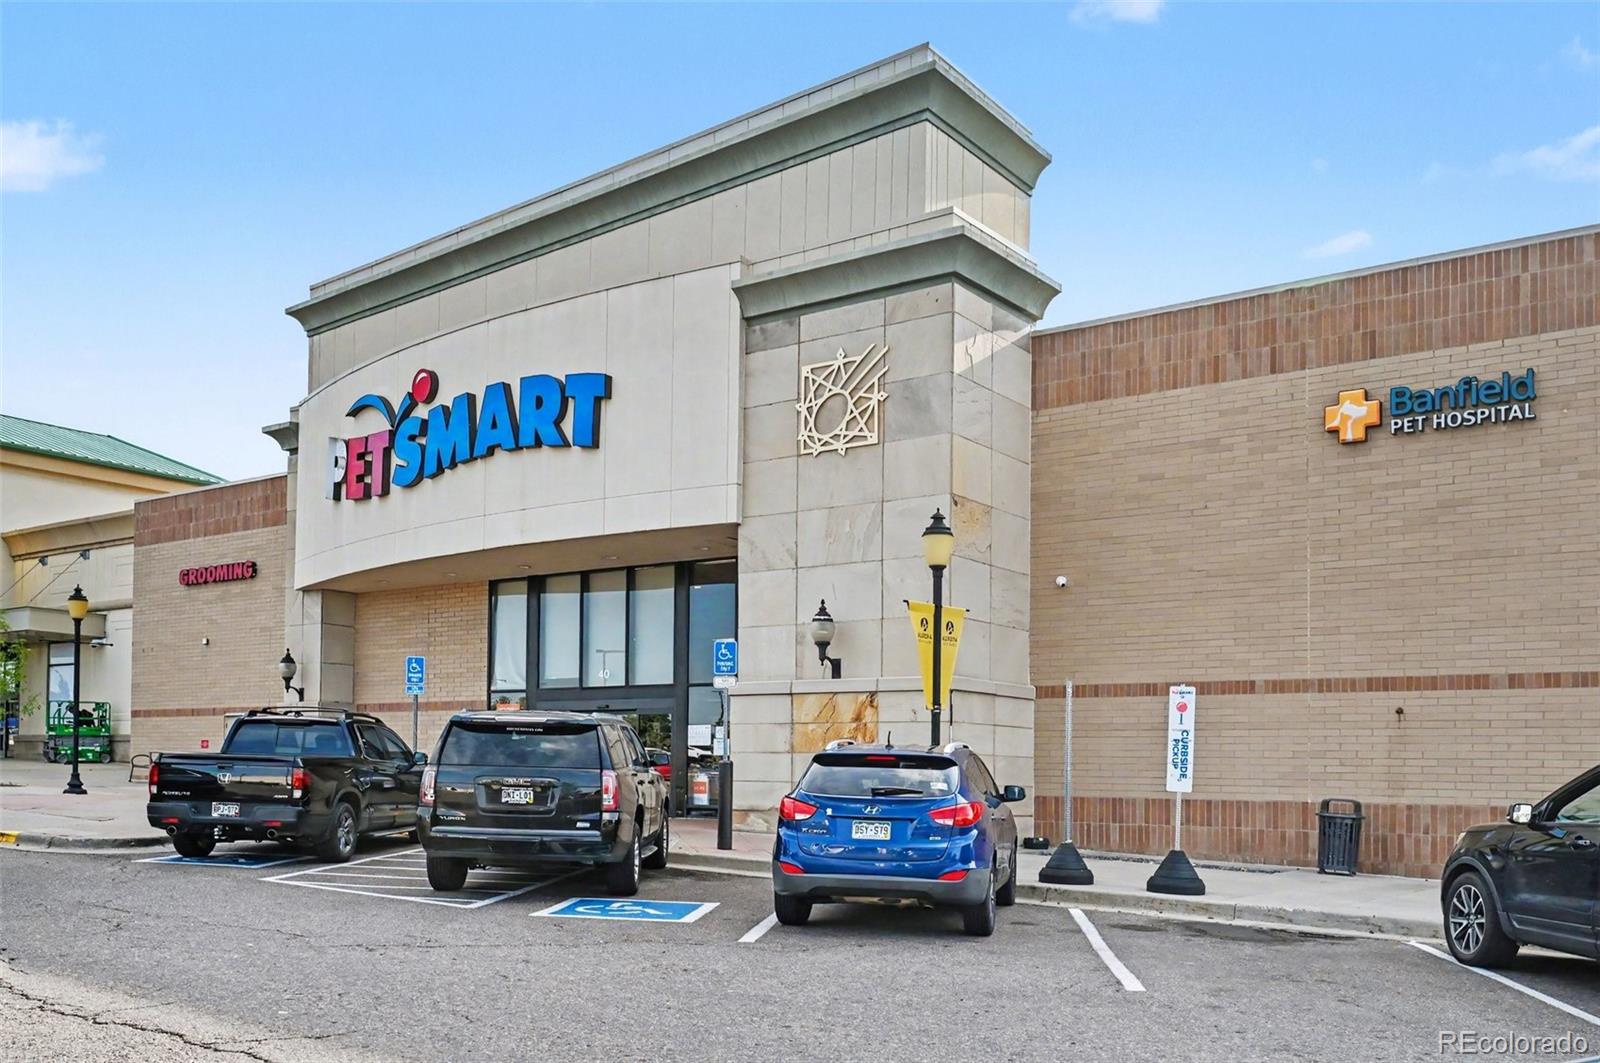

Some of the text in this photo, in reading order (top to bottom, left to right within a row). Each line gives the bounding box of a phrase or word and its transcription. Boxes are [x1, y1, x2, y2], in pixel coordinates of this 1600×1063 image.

[1389, 368, 1537, 417] Banfield
[1390, 403, 1536, 435] PET HOSPITAL
[179, 560, 257, 587] GROOMING
[1172, 738, 1180, 770] PICKUP
[1180, 729, 1190, 779] CURBSIDE
